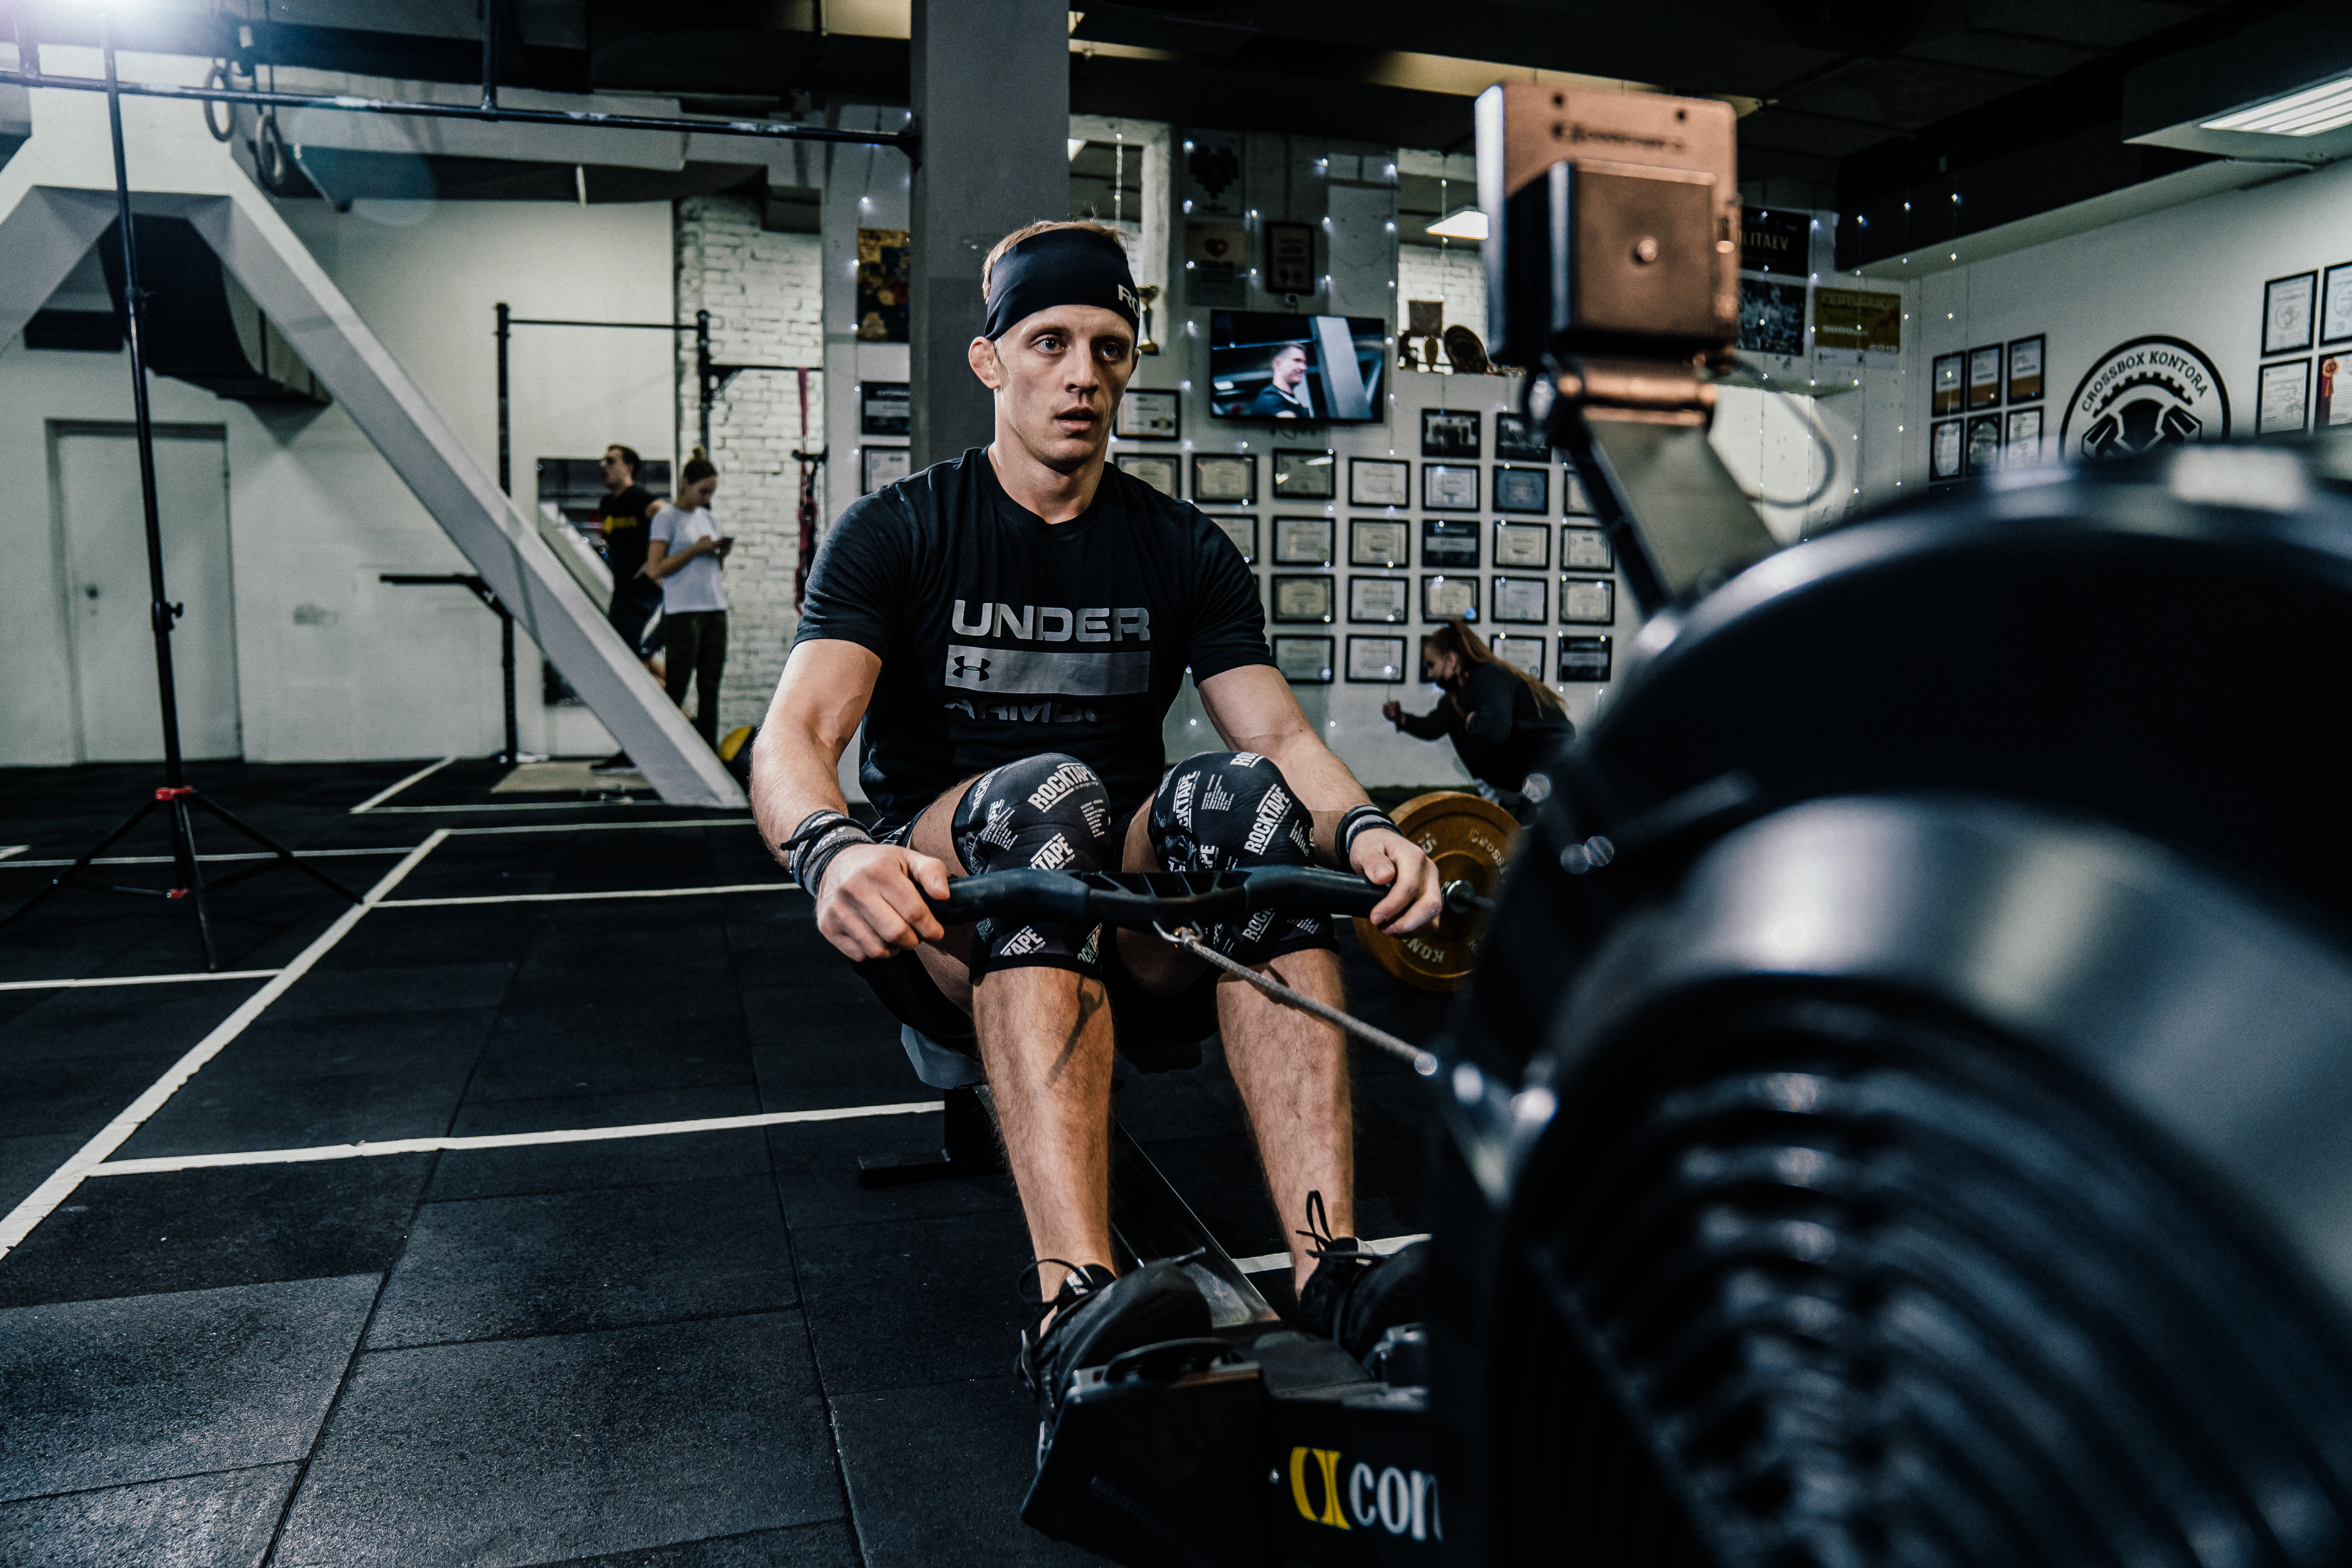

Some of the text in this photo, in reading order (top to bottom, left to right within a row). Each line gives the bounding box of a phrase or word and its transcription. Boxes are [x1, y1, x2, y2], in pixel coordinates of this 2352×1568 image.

[2082, 350, 2208, 412] CROSSBOX KONTORA
[952, 599, 1151, 642] UNDER
[1027, 765, 1097, 810] ROCKTAPE
[1243, 786, 1290, 853] ROCKTAPE
